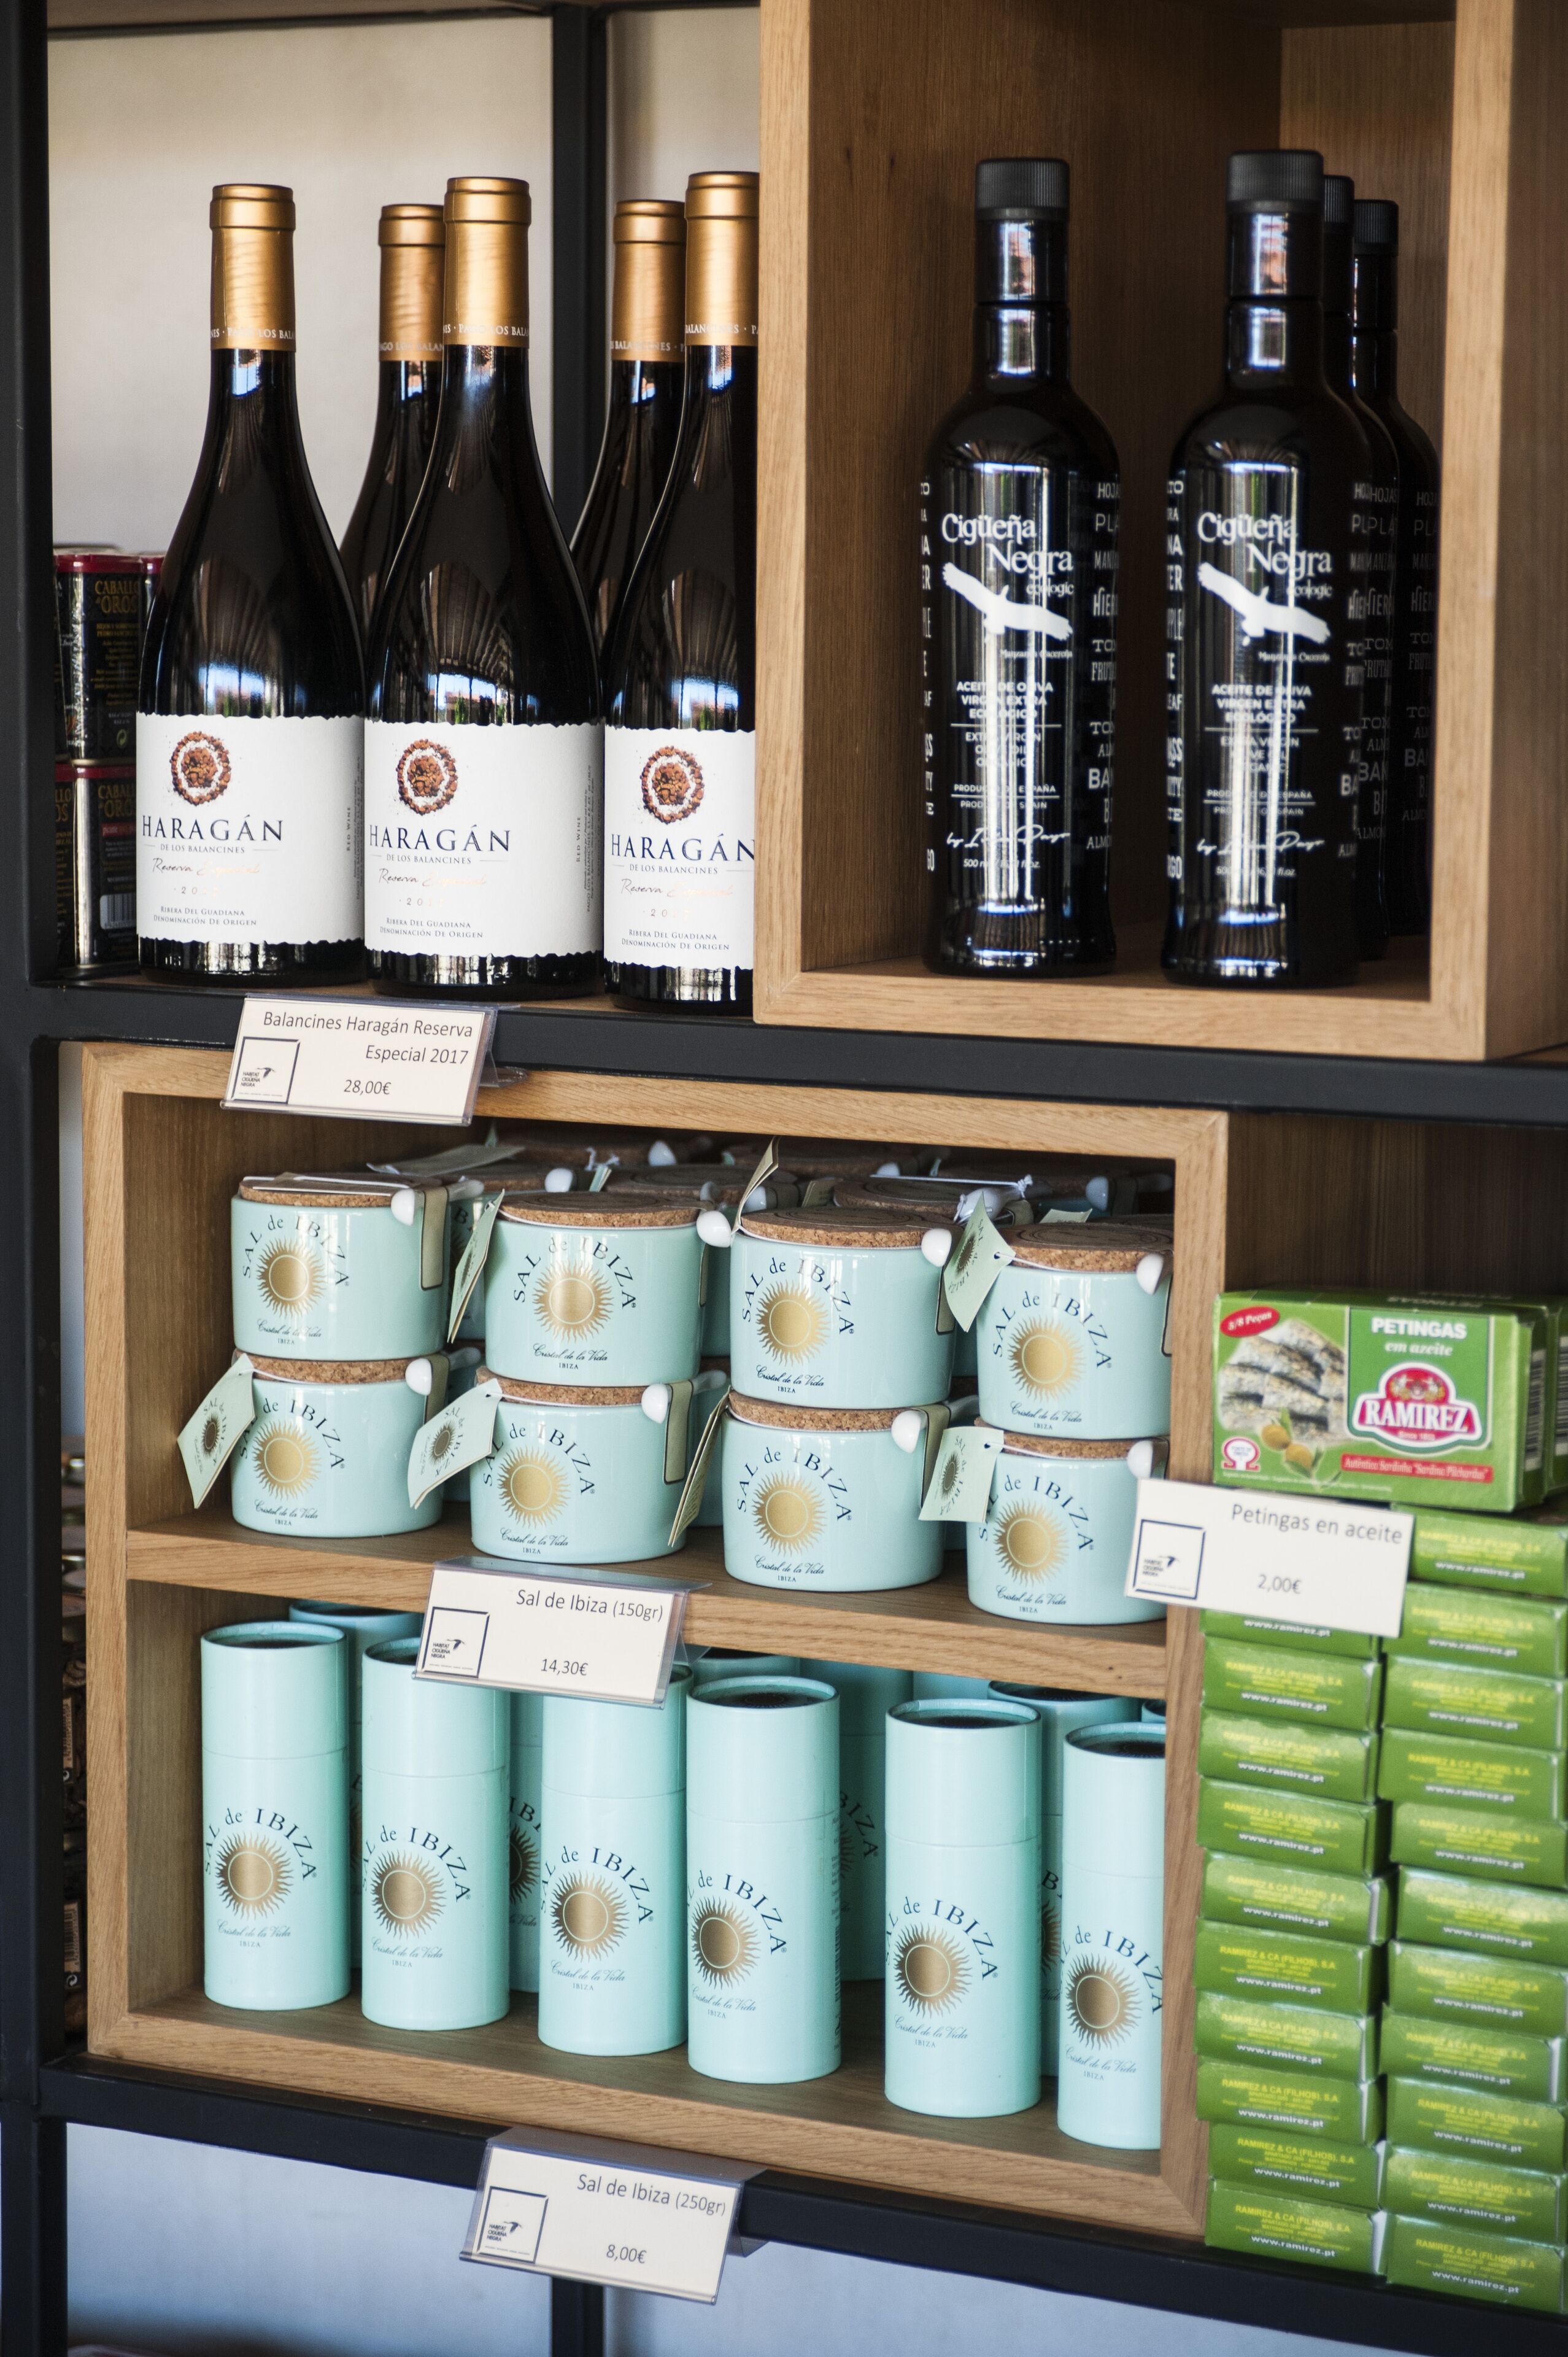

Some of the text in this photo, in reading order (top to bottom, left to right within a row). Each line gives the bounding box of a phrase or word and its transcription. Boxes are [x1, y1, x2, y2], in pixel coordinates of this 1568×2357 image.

[942, 513, 1037, 545] Cigüeña
[1197, 512, 1298, 546] Cigüeña
[986, 540, 1074, 580] Negra
[1248, 540, 1332, 580] Negra
[1255, 685, 1273, 697] DE
[142, 814, 284, 842] HARAGÁN
[369, 824, 511, 852] HARAGÁN
[188, 845, 245, 854] BALANCINES
[611, 833, 755, 861] HARAGÁN
[414, 856, 471, 864] BALANCINES
[658, 865, 718, 874] BALANCINES
[379, 868, 419, 884] Reserva
[620, 878, 663, 894] Reserva
[263, 1011, 473, 1037] Balancines Haragán Reserva
[365, 1045, 469, 1065] Especial 2017
[344, 1078, 392, 1096] 28,00€
[268, 1214, 284, 1231] de
[514, 1253, 541, 1303] SAL
[742, 1272, 763, 1323] SAL
[770, 1257, 786, 1275] de
[993, 1306, 1016, 1358] SAL
[1022, 1291, 1040, 1308] de
[1371, 1315, 1467, 1341] PETINGAS
[533, 1343, 609, 1361] Cristal de la Vida
[1384, 1341, 1454, 1357] em azeite
[756, 1364, 825, 1387] Cristal de la Vida
[263, 1397, 279, 1414] de
[1364, 1398, 1472, 1433] RAMIREZ
[509, 1423, 526, 1439] de
[737, 1463, 758, 1512] SAL
[764, 1447, 781, 1464] de
[1005, 1474, 1021, 1492] de
[1232, 1503, 1403, 1545] Petingas en aceite
[500, 1527, 527, 1544] Cristal
[548, 1535, 568, 1547] Vida
[1256, 1574, 1302, 1595] 2,00€
[516, 1589, 664, 1623] Sal de Ibiza (150gr)
[1243, 1618, 1331, 1638] www.ramirez.pt
[540, 1657, 589, 1677] 14,30€
[1241, 1690, 1328, 1712] www.ramirez.pt
[1425, 1782, 1516, 1803] www.ramirez.pt
[225, 1808, 242, 1825] de
[380, 1825, 397, 1843] de
[561, 1845, 579, 1864] de
[698, 1870, 713, 1888] de
[903, 1896, 921, 1914] de
[1243, 1906, 1330, 1928] www.ramirez.pt
[1075, 1925, 1091, 1945] de
[573, 1982, 594, 1991] IBIZA
[1235, 1975, 1323, 1995] www.ramirez.pt
[1222, 2079, 1259, 2091] RAMIREZ
[1238, 2108, 1324, 2128] www.ramirez.pt
[1254, 2167, 1340, 2188] www.ramirez.pt
[577, 2173, 726, 2216] Sal de Ibiza (250gr)
[1427, 2201, 1516, 2223] www.ramirez.pt
[606, 2244, 647, 2264] 8,00€
[1251, 2234, 1336, 2257] www.ramirez.pt
[1432, 2270, 1520, 2294] www.ramirez.pt
